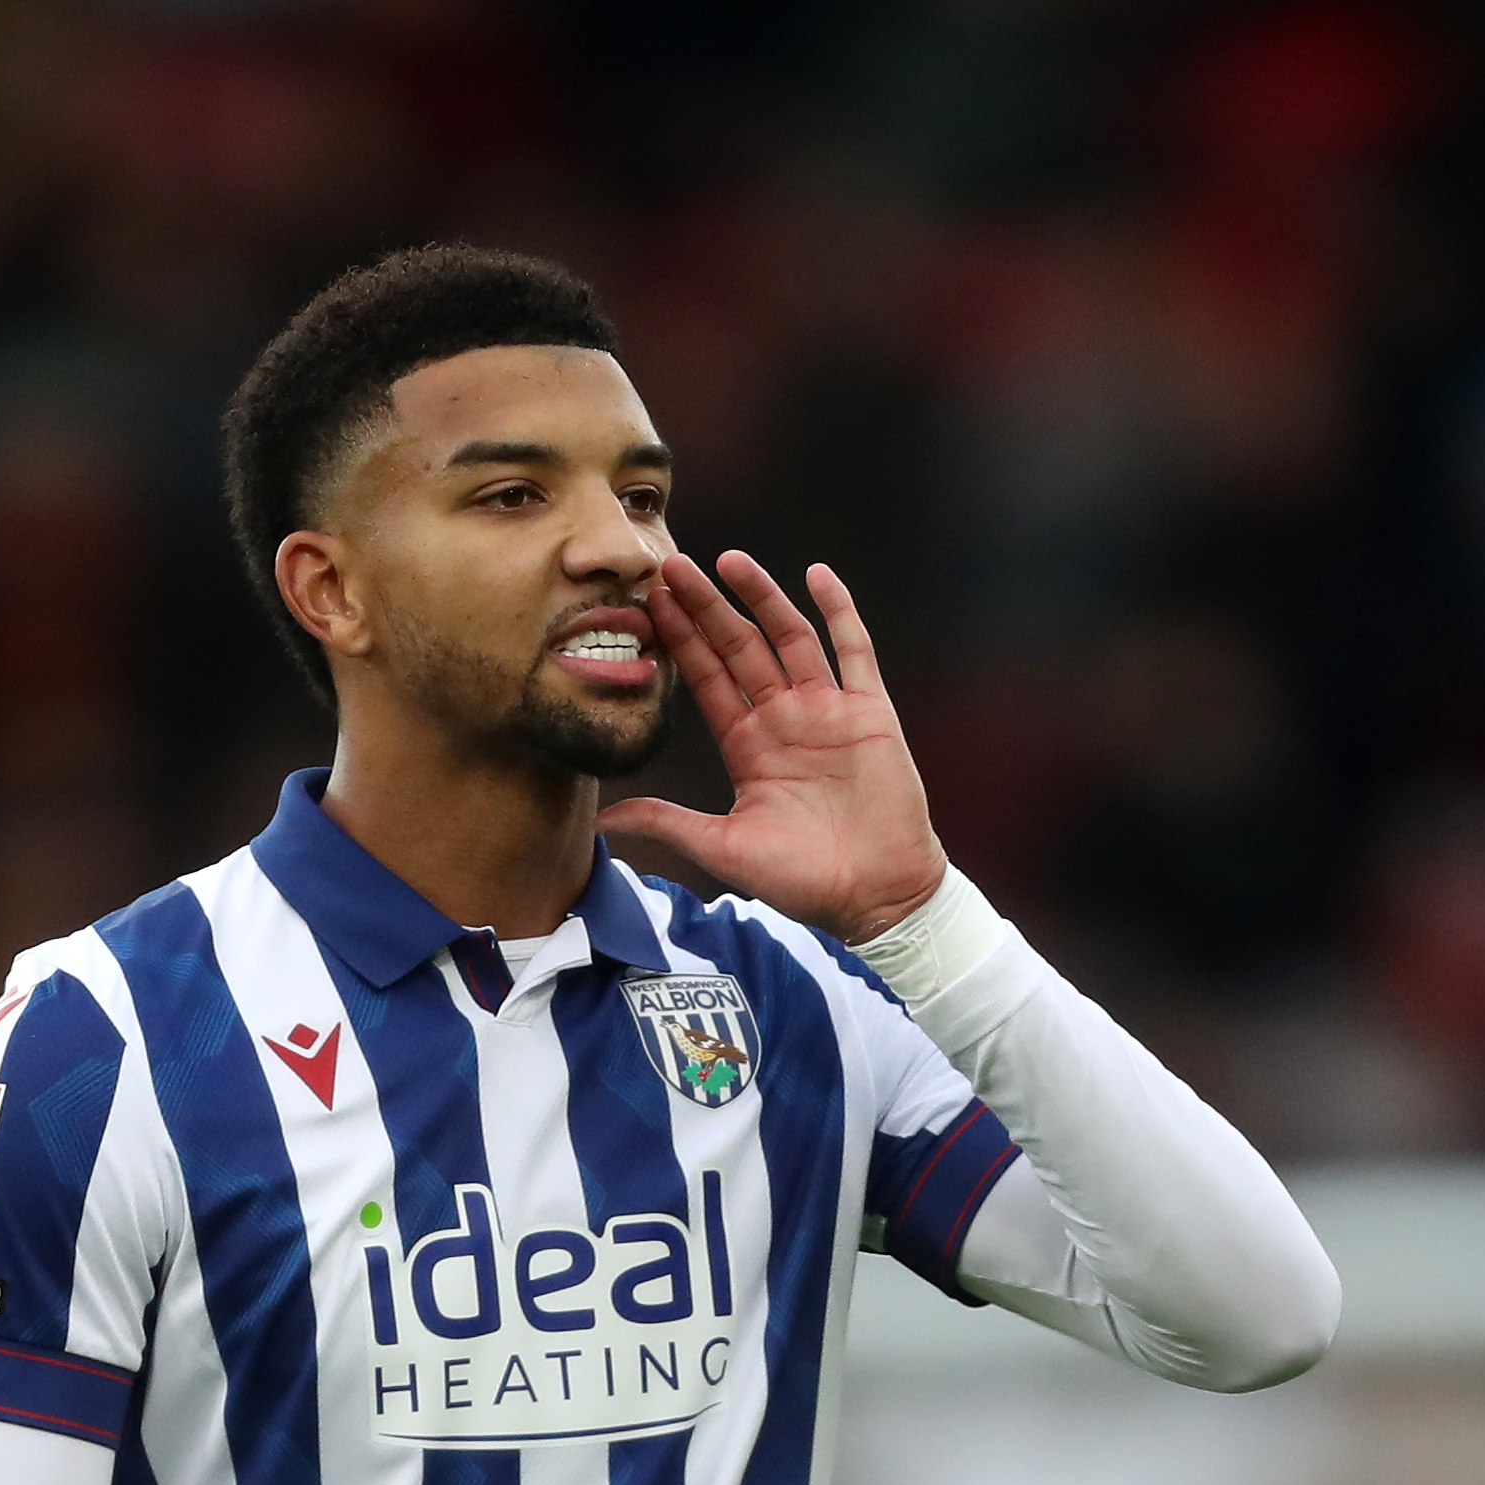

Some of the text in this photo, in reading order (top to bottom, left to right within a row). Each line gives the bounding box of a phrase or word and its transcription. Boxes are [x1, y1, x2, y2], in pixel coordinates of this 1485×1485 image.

[628, 980, 730, 992] WEST BROMWICH
[640, 990, 740, 1012] ALBION
[359, 1170, 733, 1346] ideal
[374, 1337, 731, 1415] HEATING
